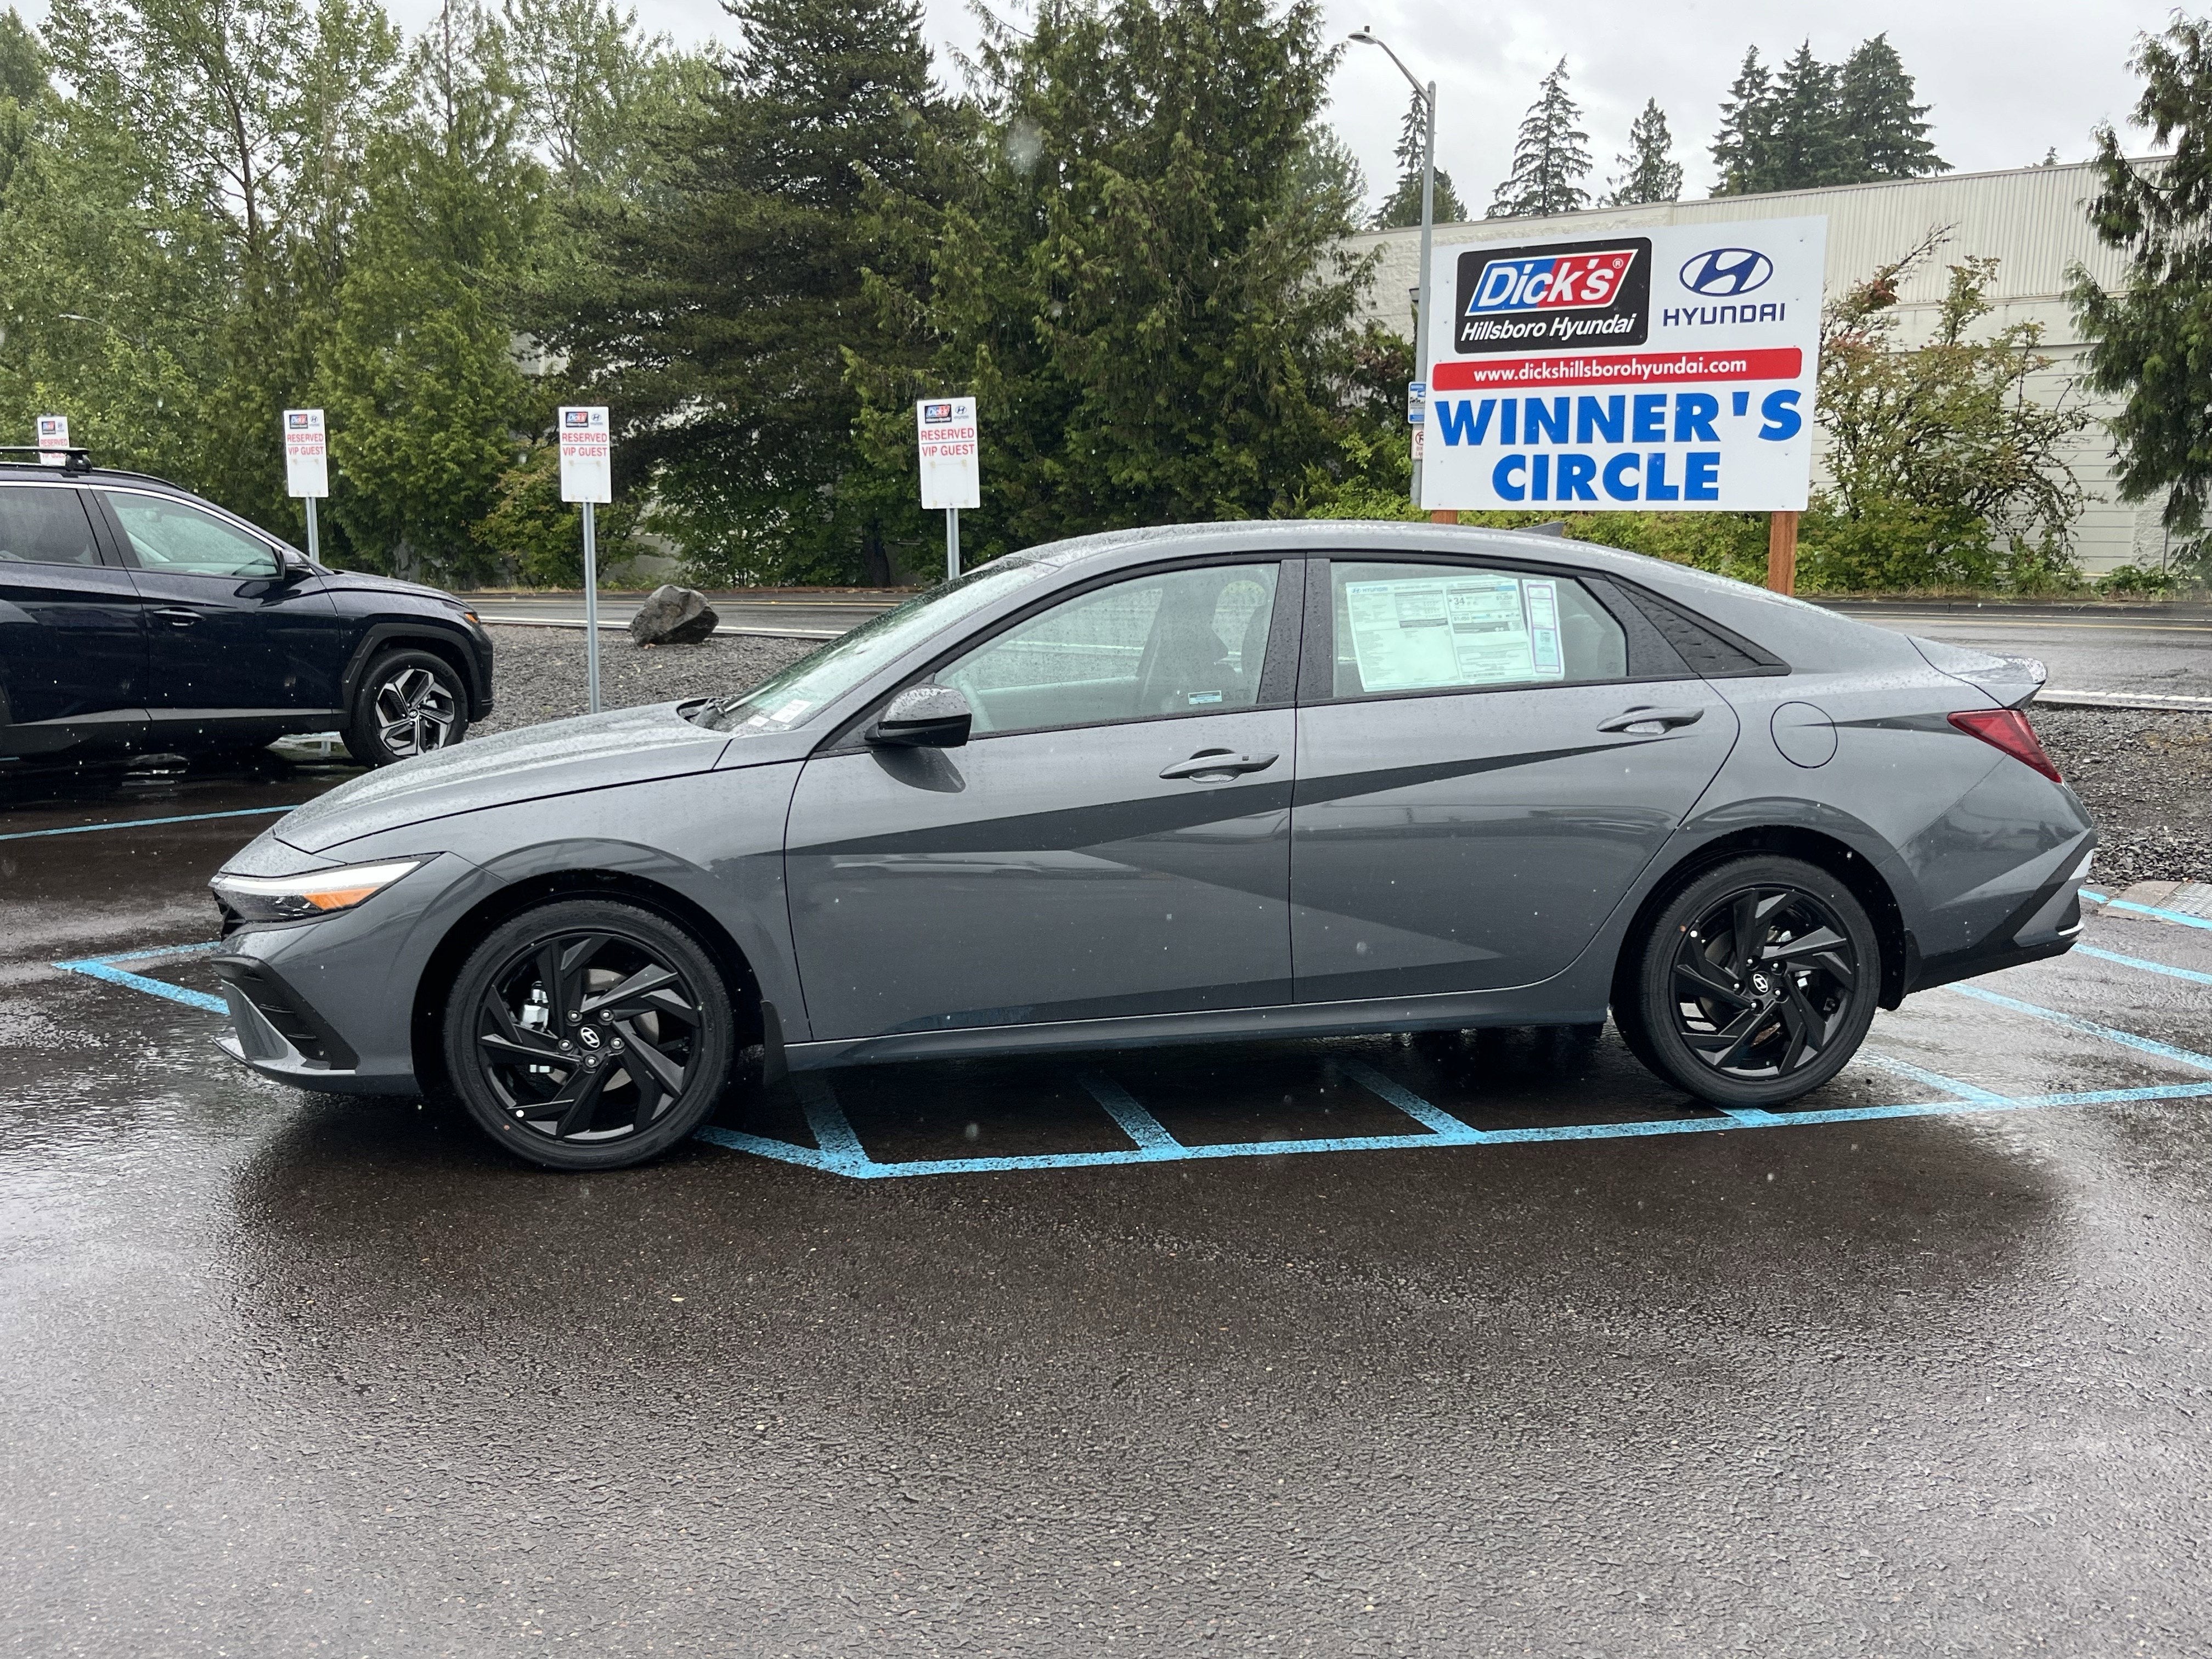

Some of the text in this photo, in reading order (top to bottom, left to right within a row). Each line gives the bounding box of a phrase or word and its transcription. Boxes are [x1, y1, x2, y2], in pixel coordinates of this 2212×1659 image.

[1663, 303, 1786, 327] HYUNDAI
[1461, 313, 1637, 341] Hillsboro Hyundai
[1474, 357, 1747, 381] www.dickshillsborohyundai.com
[1434, 389, 1802, 447] WINNER'S
[287, 433, 324, 442] RESERVED
[562, 433, 607, 443] RESERVED
[921, 428, 974, 441] RESERVED
[40, 439, 68, 447] RESERVED
[288, 447, 324, 455] VIP GUEST
[563, 447, 607, 456] VIP GUEST
[922, 444, 974, 456] VIP GUEST
[1492, 452, 1721, 501] CIRCLE
